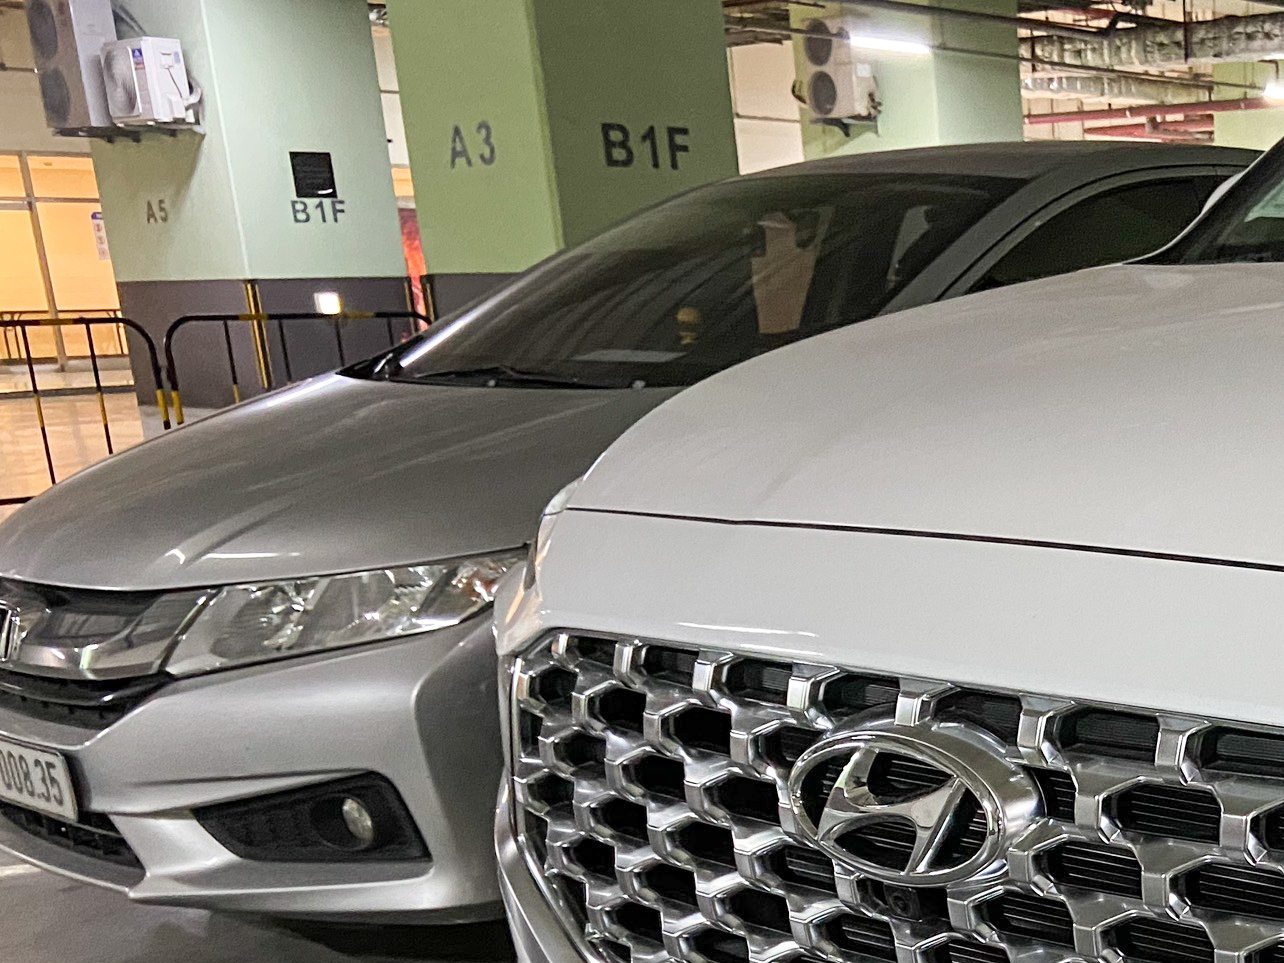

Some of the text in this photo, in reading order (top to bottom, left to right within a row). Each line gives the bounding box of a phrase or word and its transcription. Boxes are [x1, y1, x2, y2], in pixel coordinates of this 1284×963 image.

[450, 120, 496, 169] A3
[601, 122, 690, 170] B1F
[146, 198, 169, 224] A5
[290, 199, 346, 223] B1F
